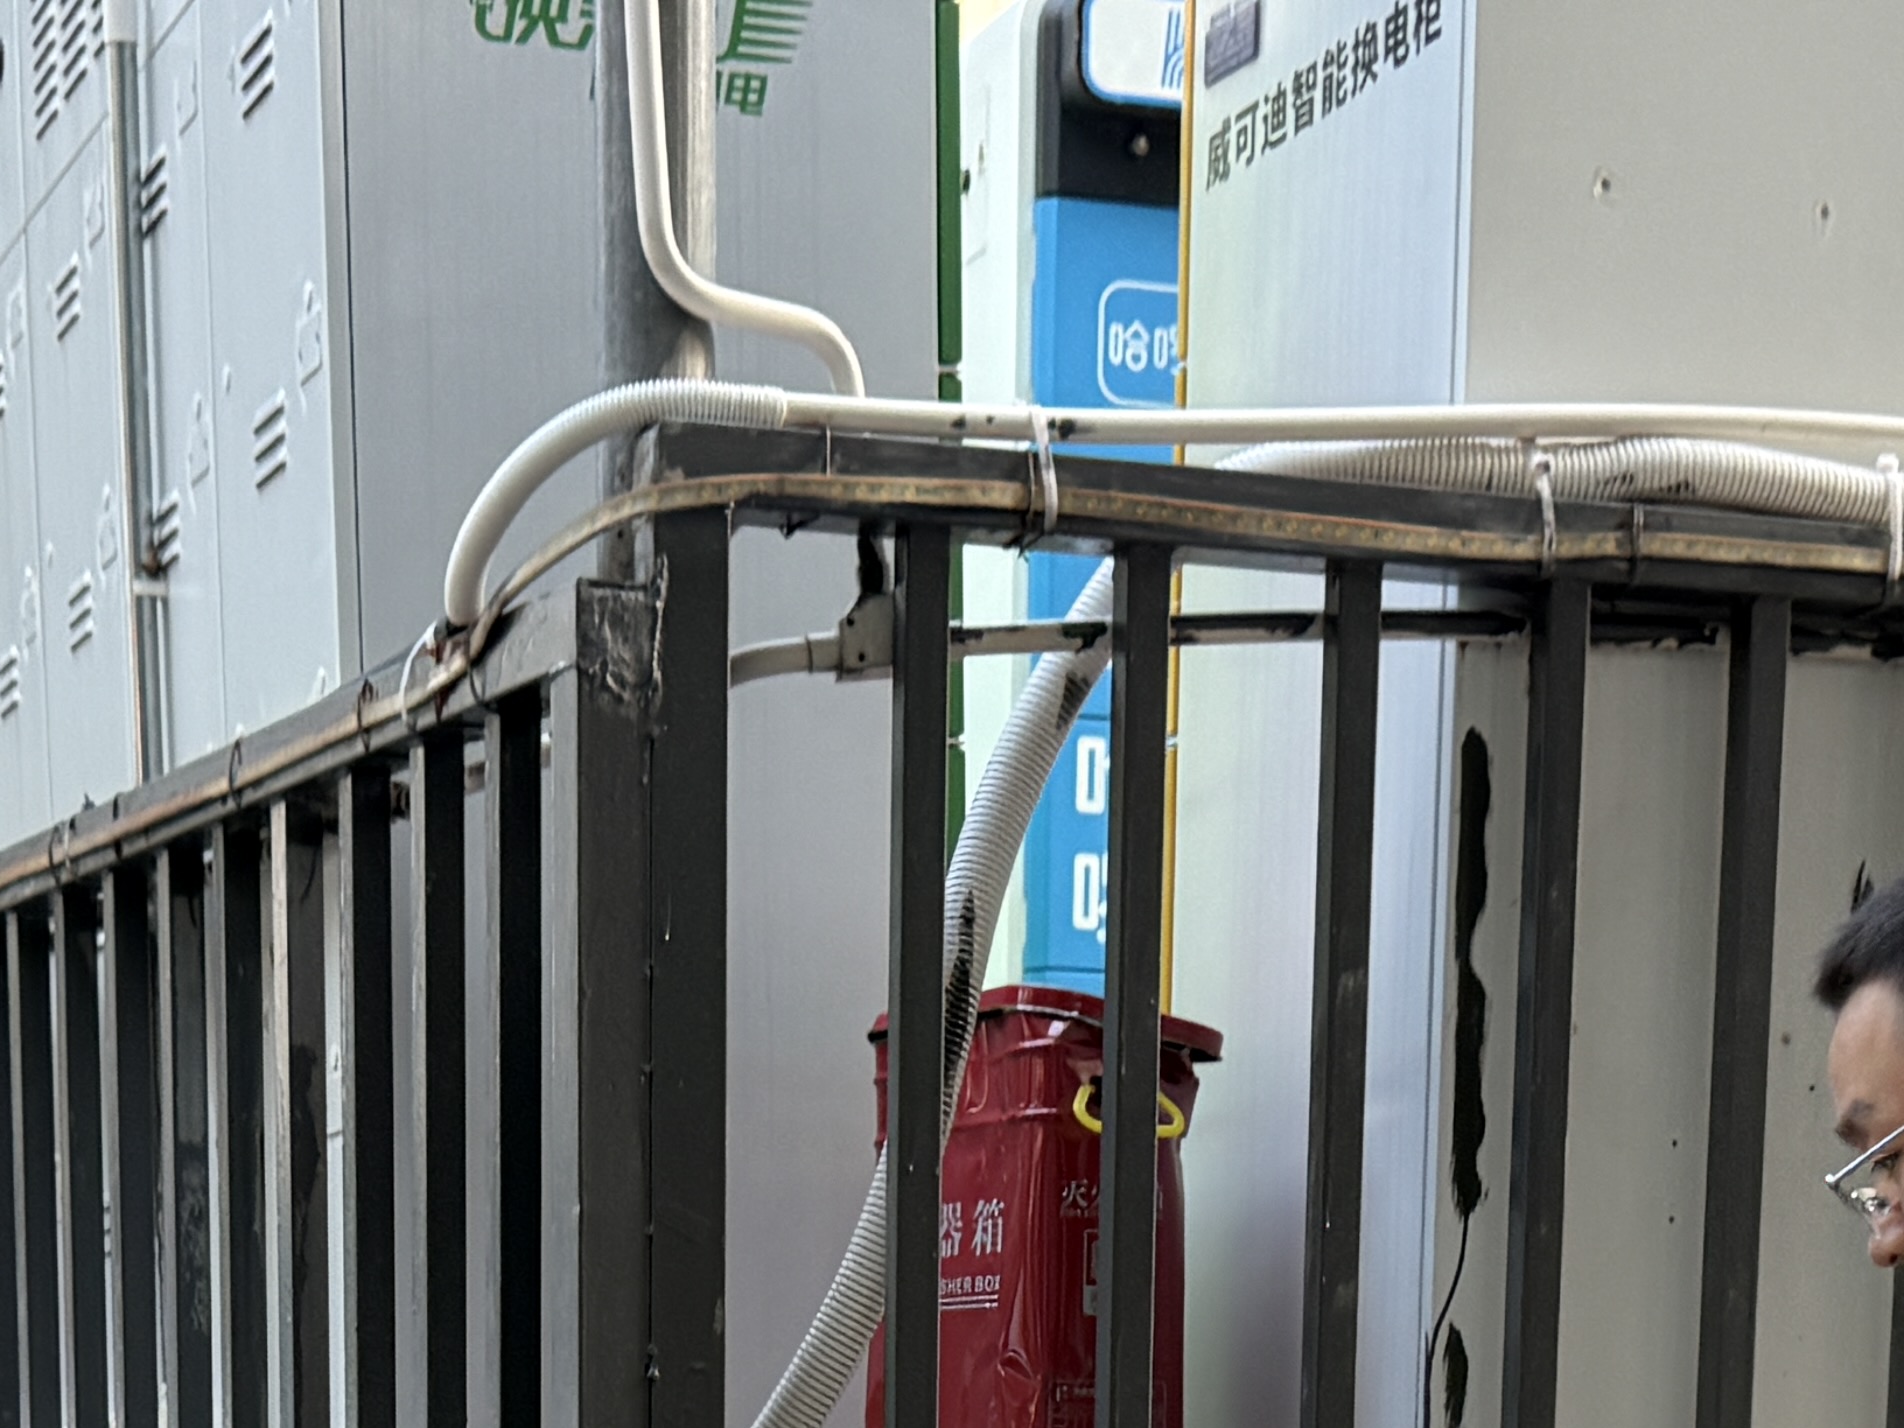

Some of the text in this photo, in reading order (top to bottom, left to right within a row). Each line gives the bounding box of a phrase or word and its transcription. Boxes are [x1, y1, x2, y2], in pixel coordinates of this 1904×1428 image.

[1206, 0, 1443, 191] 威可迪智能换电柜
